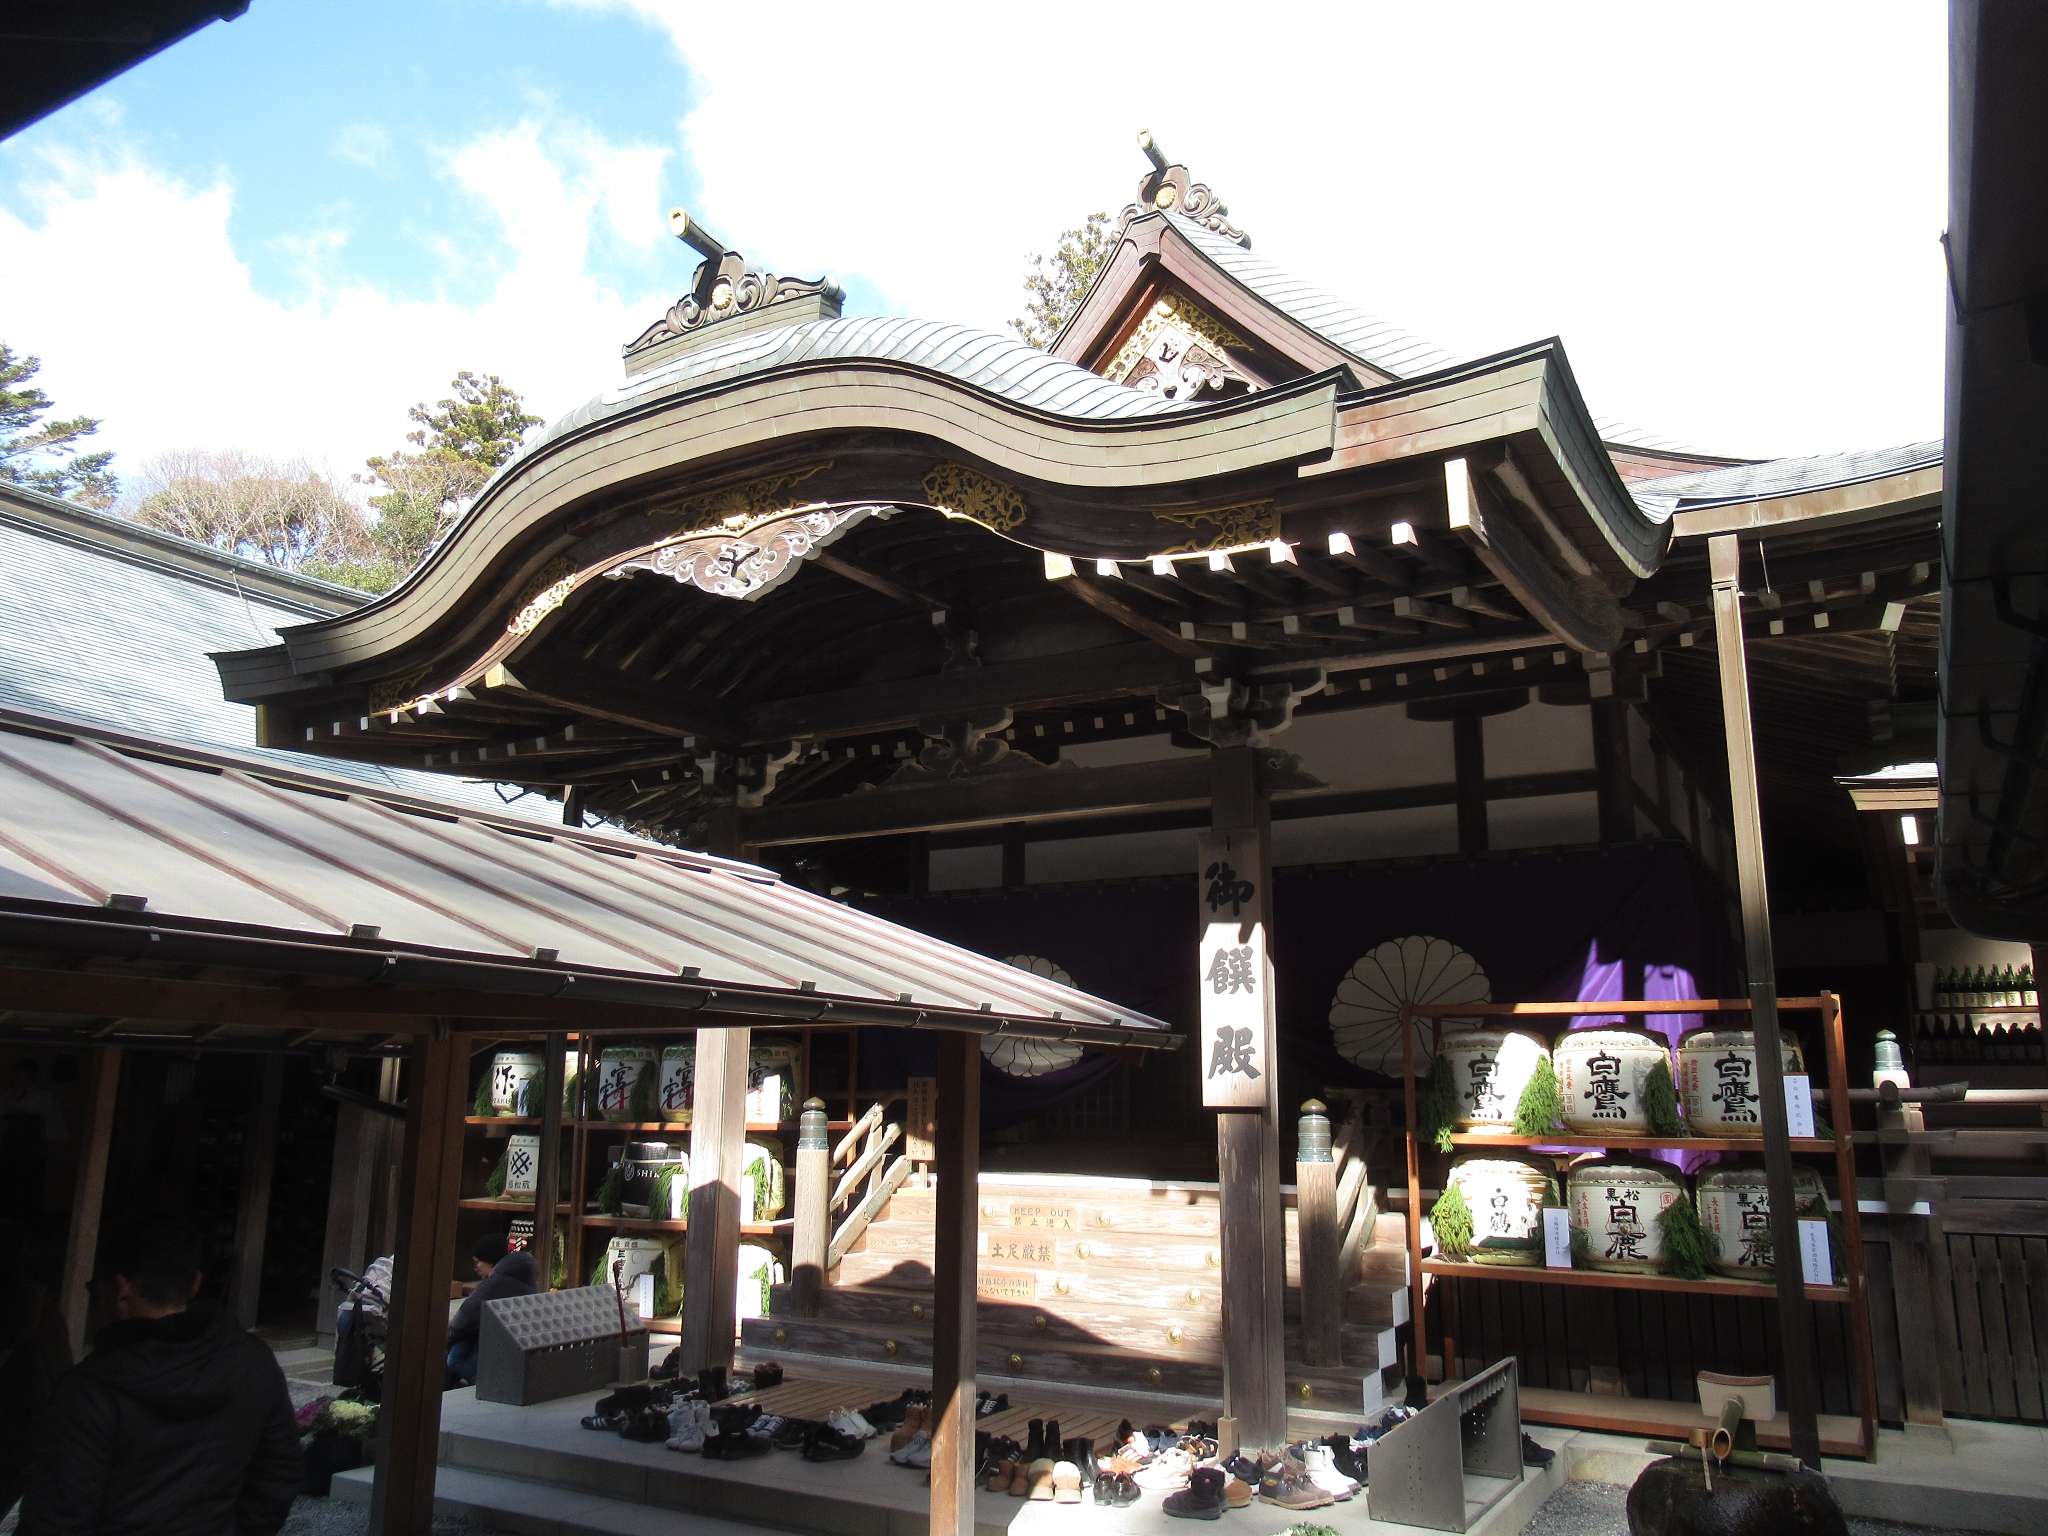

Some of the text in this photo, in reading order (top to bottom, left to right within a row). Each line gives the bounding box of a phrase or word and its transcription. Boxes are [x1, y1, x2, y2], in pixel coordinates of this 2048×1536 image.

[1204, 861, 1262, 1081] 御饌殿
[1584, 1049, 1631, 1119] 白鷹
[1712, 1050, 1760, 1123] 白鷹
[1014, 1207, 1072, 1218] KEEP OUT
[1604, 1187, 1641, 1202] 黒松
[991, 1242, 1052, 1262] 土足厳禁
